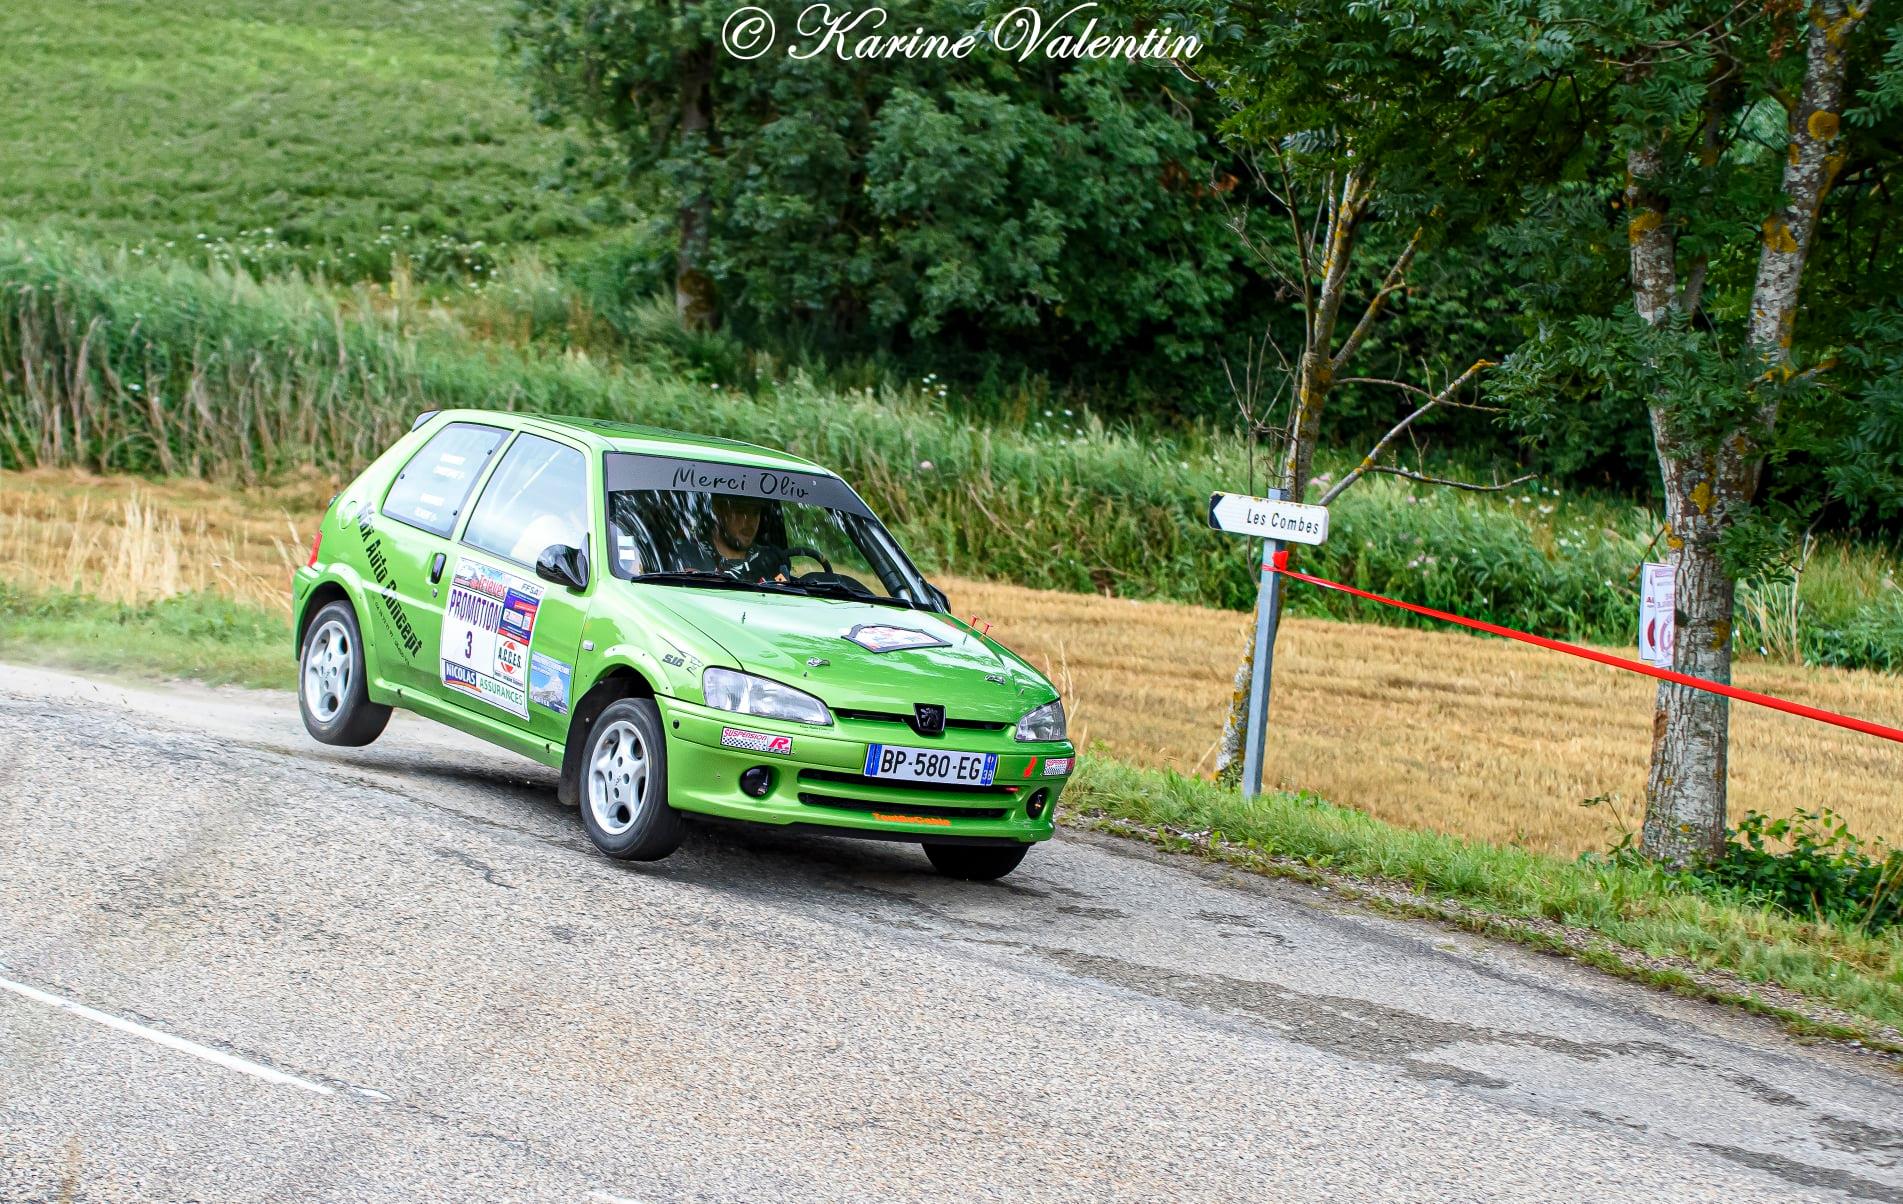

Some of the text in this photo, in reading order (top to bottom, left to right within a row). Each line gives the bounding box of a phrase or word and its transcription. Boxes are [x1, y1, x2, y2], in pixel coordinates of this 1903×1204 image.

[672, 464, 809, 498] Merci Oliv
[1247, 509, 1319, 534] Les Combes
[366, 539, 388, 583] Auto
[381, 579, 423, 658] Concept
[521, 583, 539, 596] FFSA
[449, 589, 503, 634] PROMOTION
[465, 630, 473, 659] 3
[446, 662, 476, 686] NICOLAS
[480, 677, 523, 706] ASSURANCES
[880, 749, 982, 780] BP-580-EG
[982, 769, 993, 780] 38
